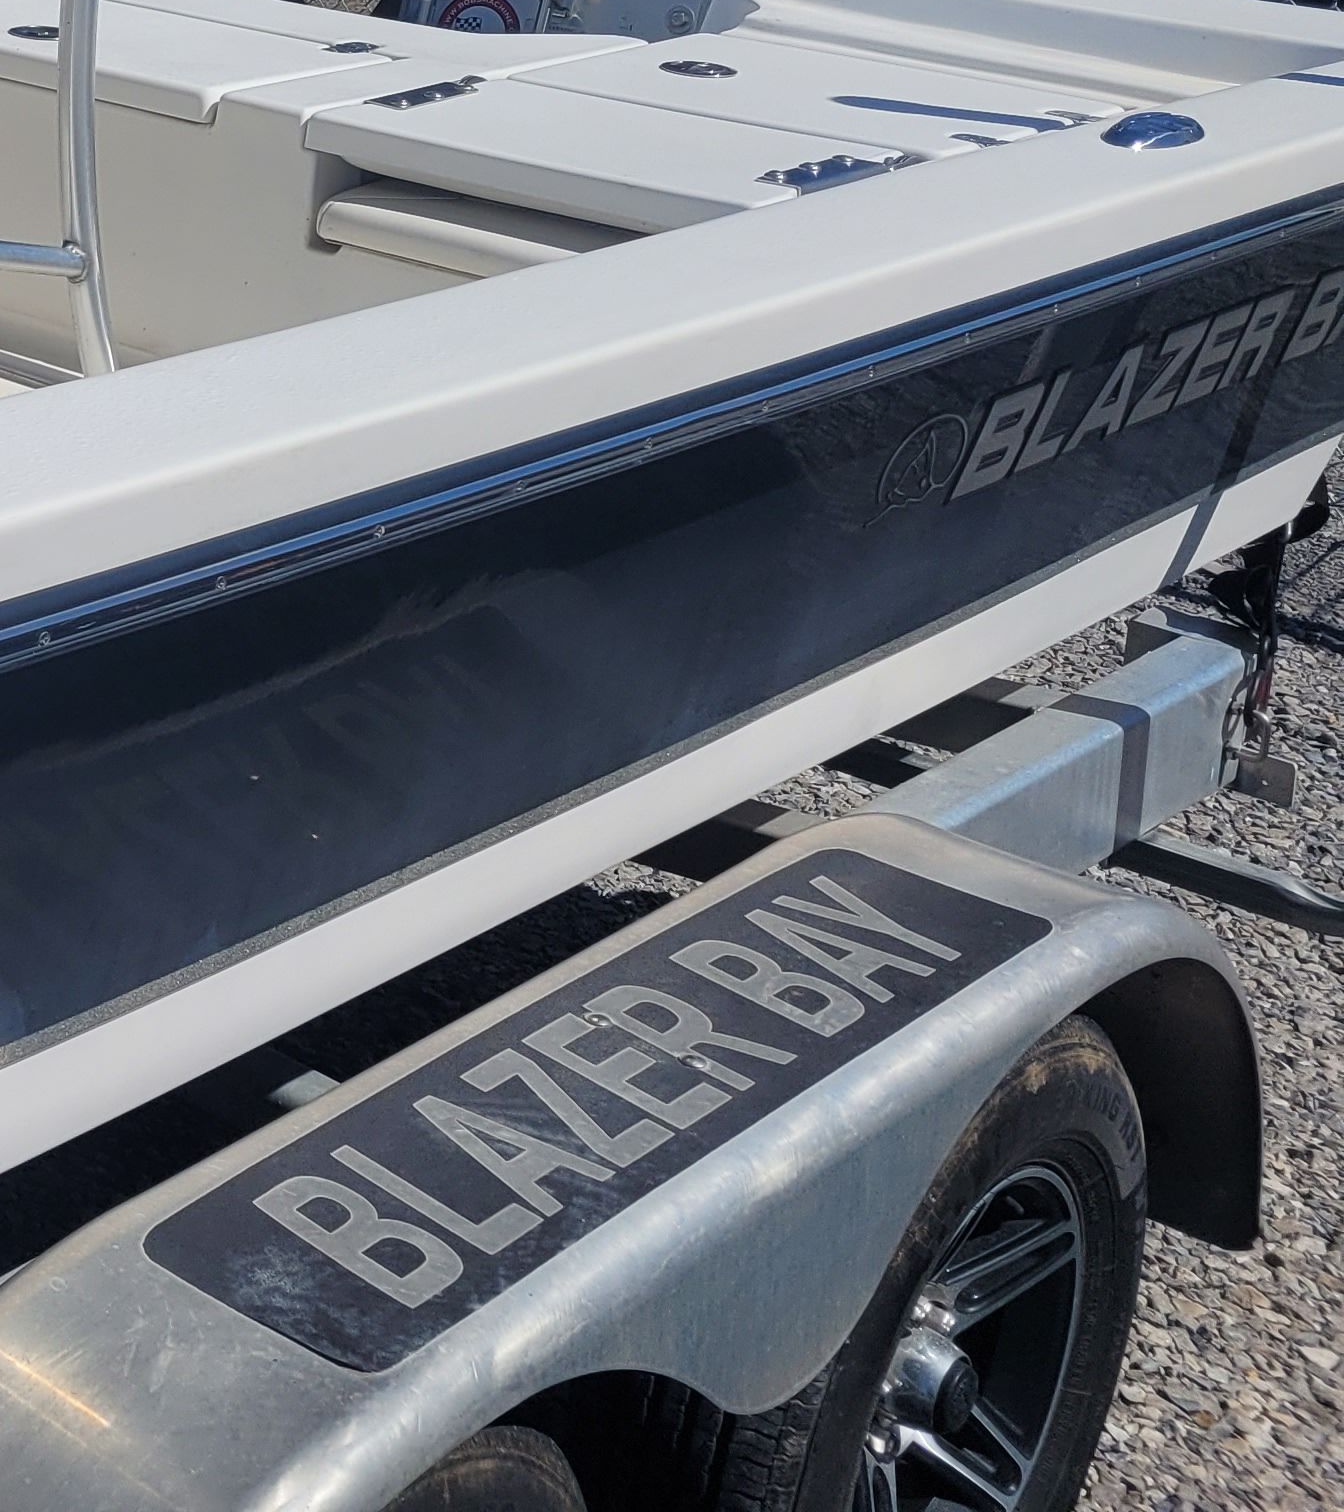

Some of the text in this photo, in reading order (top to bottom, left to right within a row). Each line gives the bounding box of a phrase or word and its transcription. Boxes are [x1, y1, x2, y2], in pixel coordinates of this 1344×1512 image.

[945, 289, 1297, 506] BLAZER
[252, 874, 962, 1309] BLAZER BAY
